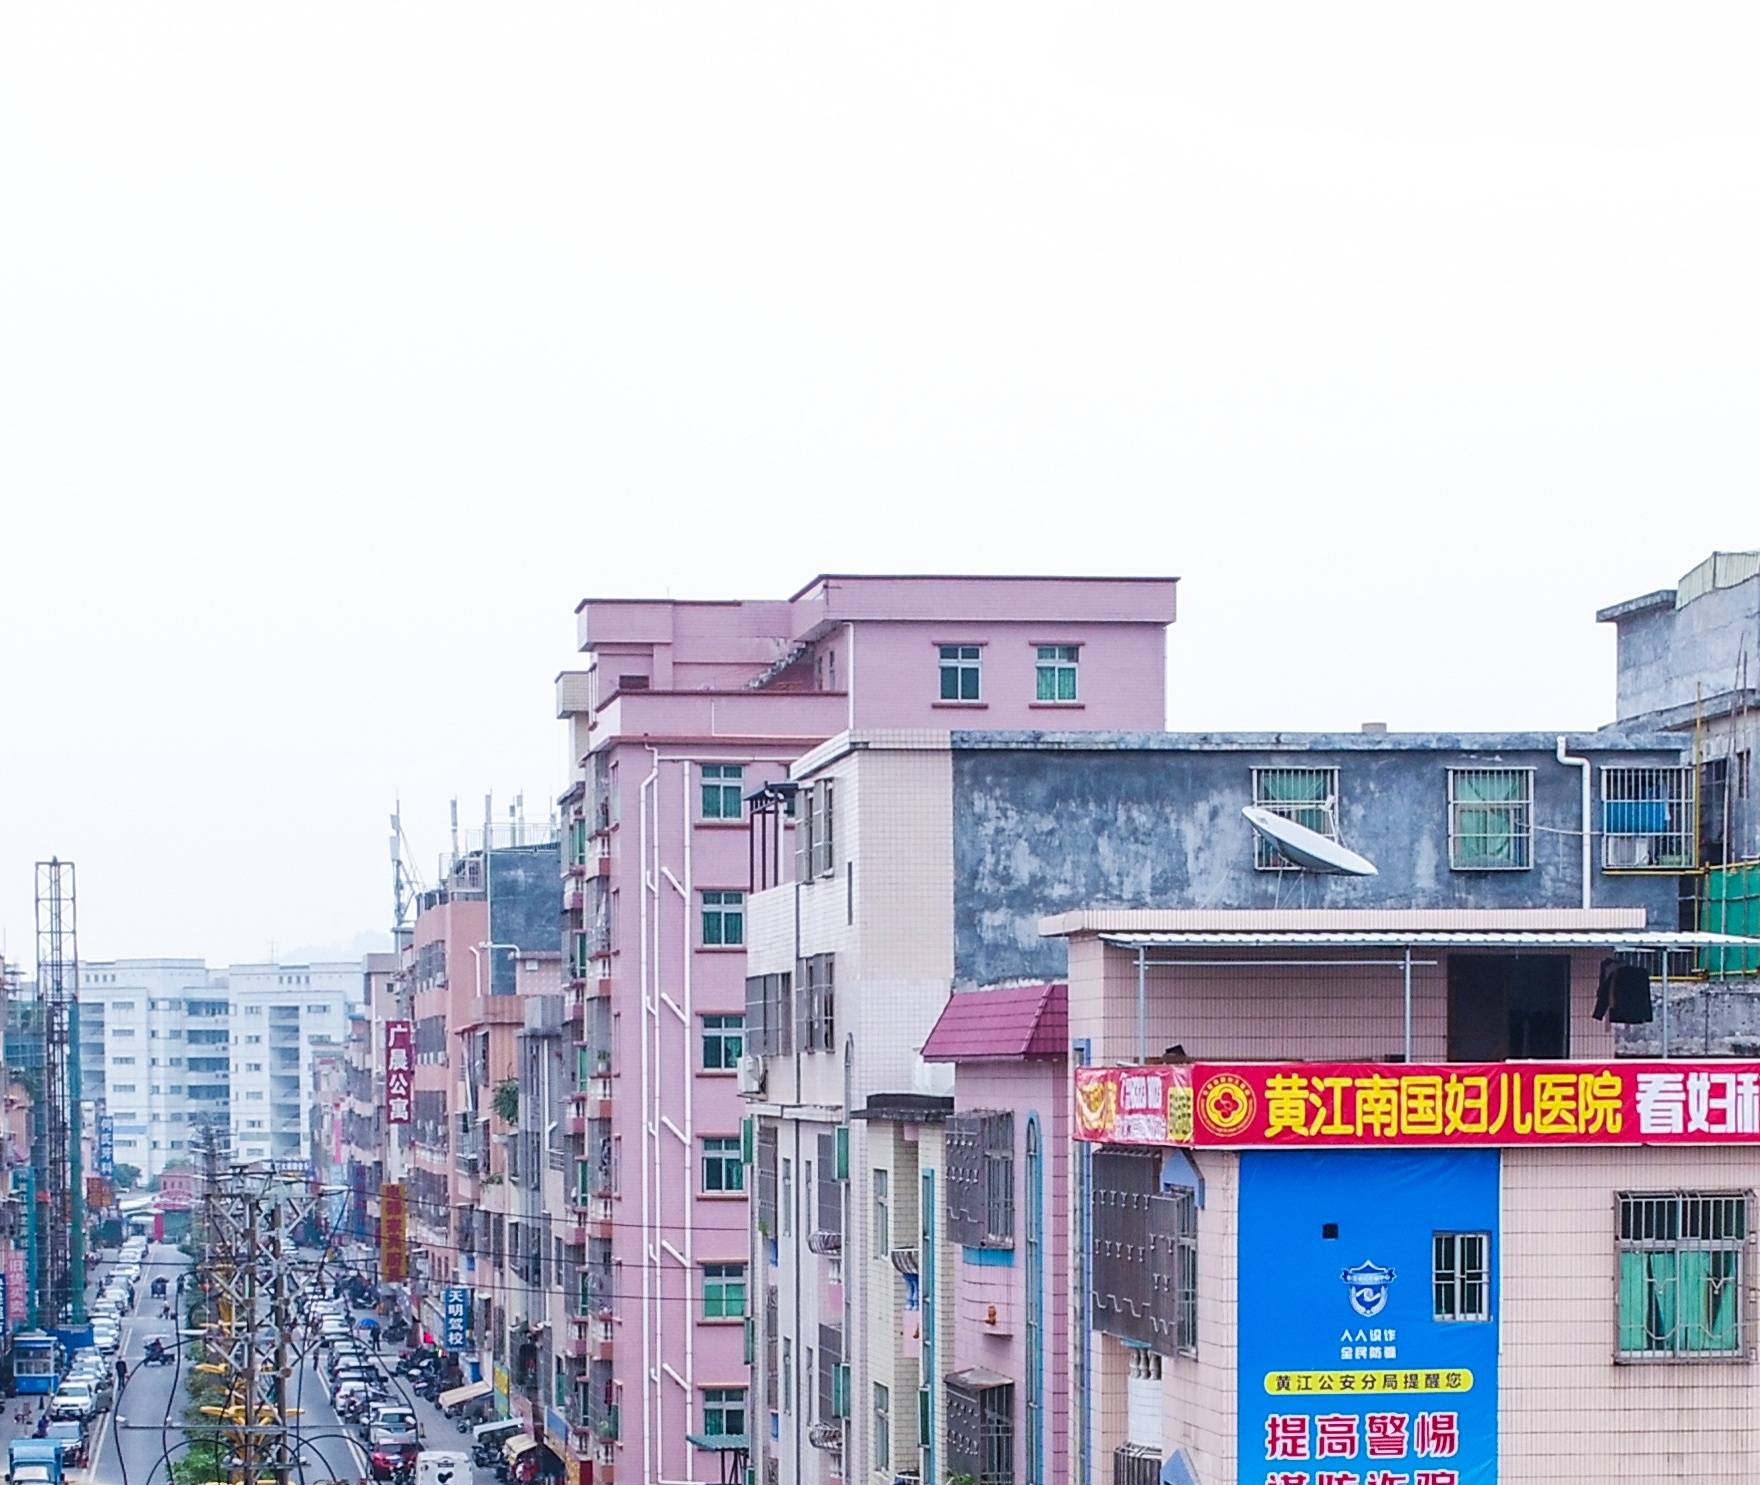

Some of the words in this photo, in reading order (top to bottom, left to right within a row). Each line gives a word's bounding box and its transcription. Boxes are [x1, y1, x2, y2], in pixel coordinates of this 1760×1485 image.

[1263, 1070, 1623, 1138] 黄江南国妇儿医院
[448, 1289, 468, 1345] 天明驾校
[1275, 1372, 1463, 1392] 黄江公安分局提醒您
[1265, 1412, 1460, 1461] 提高警惕
